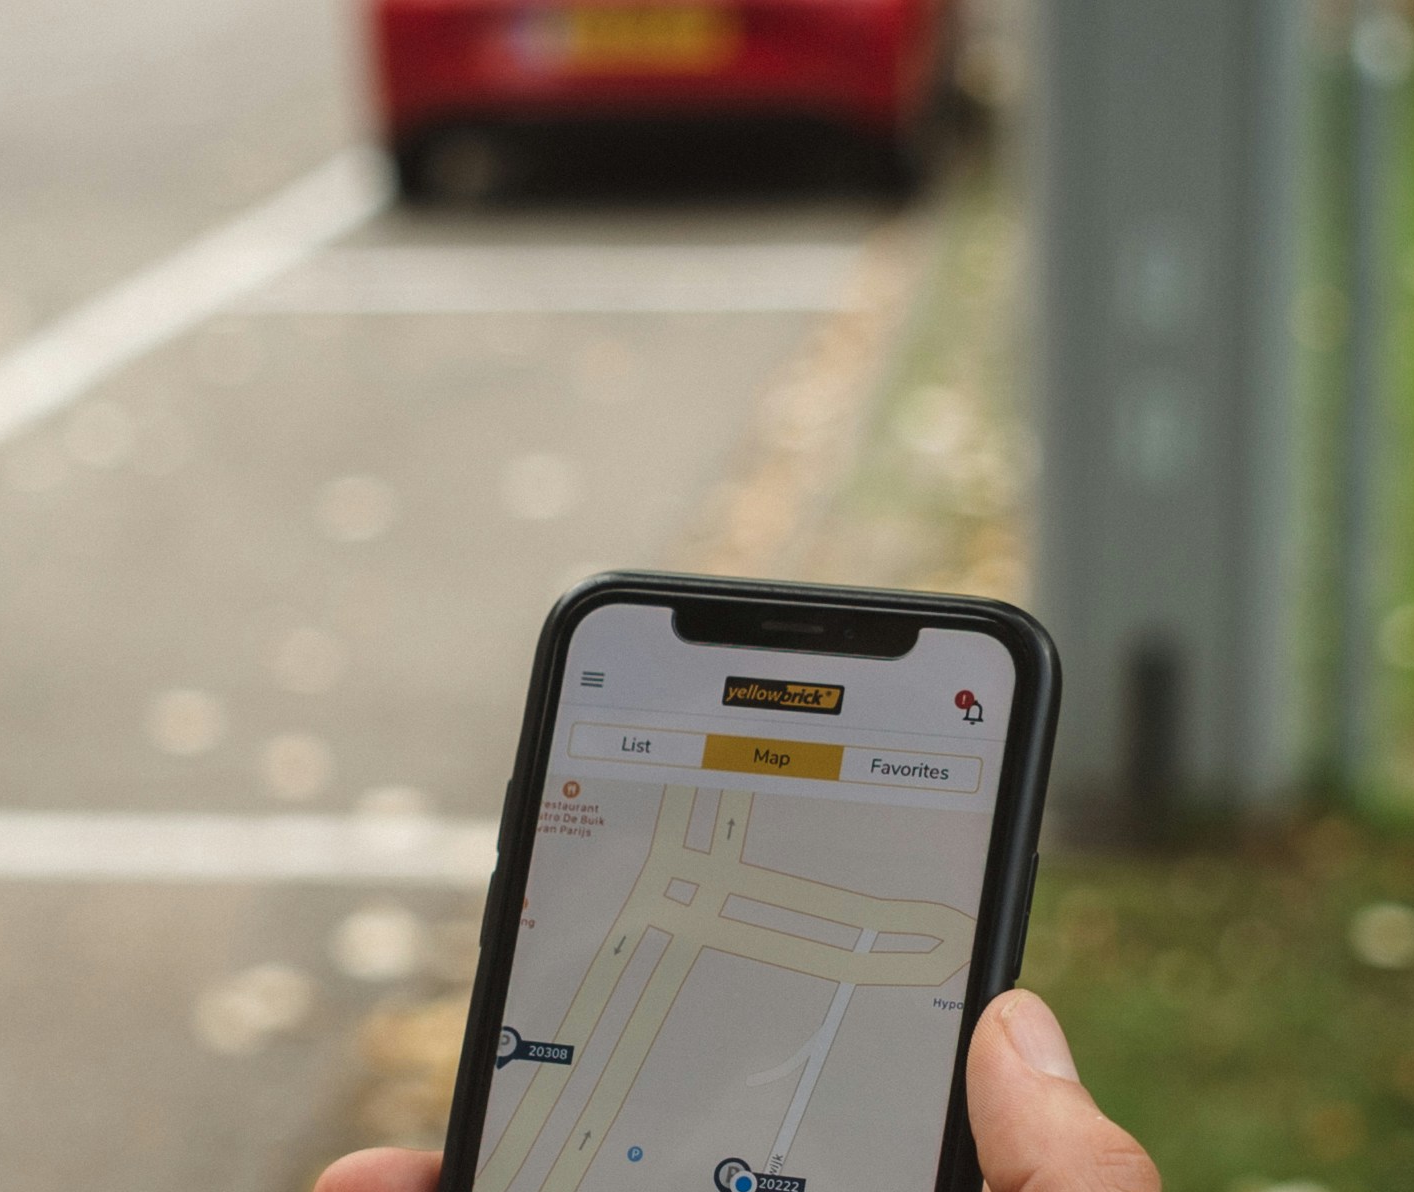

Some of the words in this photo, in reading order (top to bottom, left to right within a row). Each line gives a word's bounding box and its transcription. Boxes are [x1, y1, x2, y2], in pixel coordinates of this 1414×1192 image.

[621, 736, 652, 754] List
[753, 748, 791, 768] Map
[870, 758, 950, 781] Favorites
[544, 801, 599, 814] estaurant
[563, 813, 578, 824] De
[581, 814, 605, 827] Buik
[560, 825, 592, 838] Parijs
[528, 1045, 568, 1060] 20308
[759, 1177, 800, 1192] 20222
